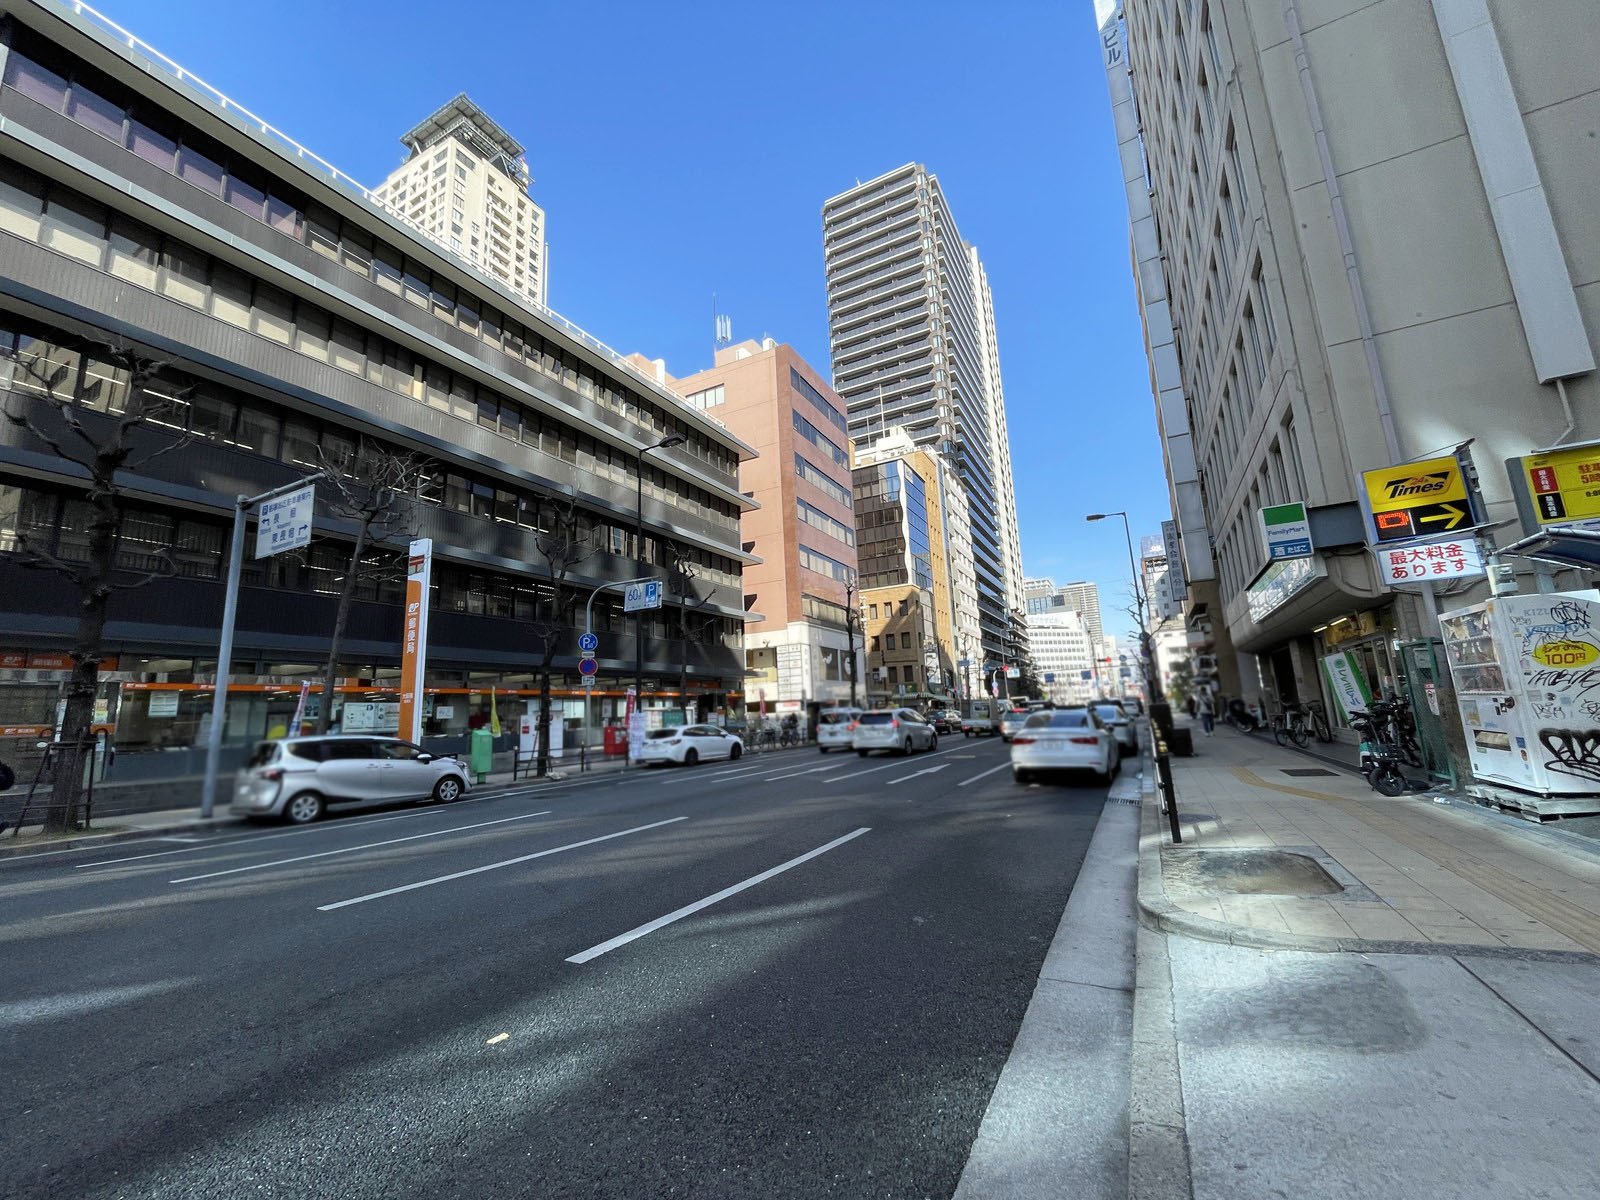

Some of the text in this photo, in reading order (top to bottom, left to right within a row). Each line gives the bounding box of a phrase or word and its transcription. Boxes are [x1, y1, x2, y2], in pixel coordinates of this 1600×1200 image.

[1384, 472, 1449, 499] Times
[1268, 526, 1305, 536] FamilyMart
[1287, 544, 1308, 554] たばこ
[1389, 543, 1465, 566] 最大料金
[1391, 558, 1468, 580] あります
[1544, 652, 1587, 666] 100円
